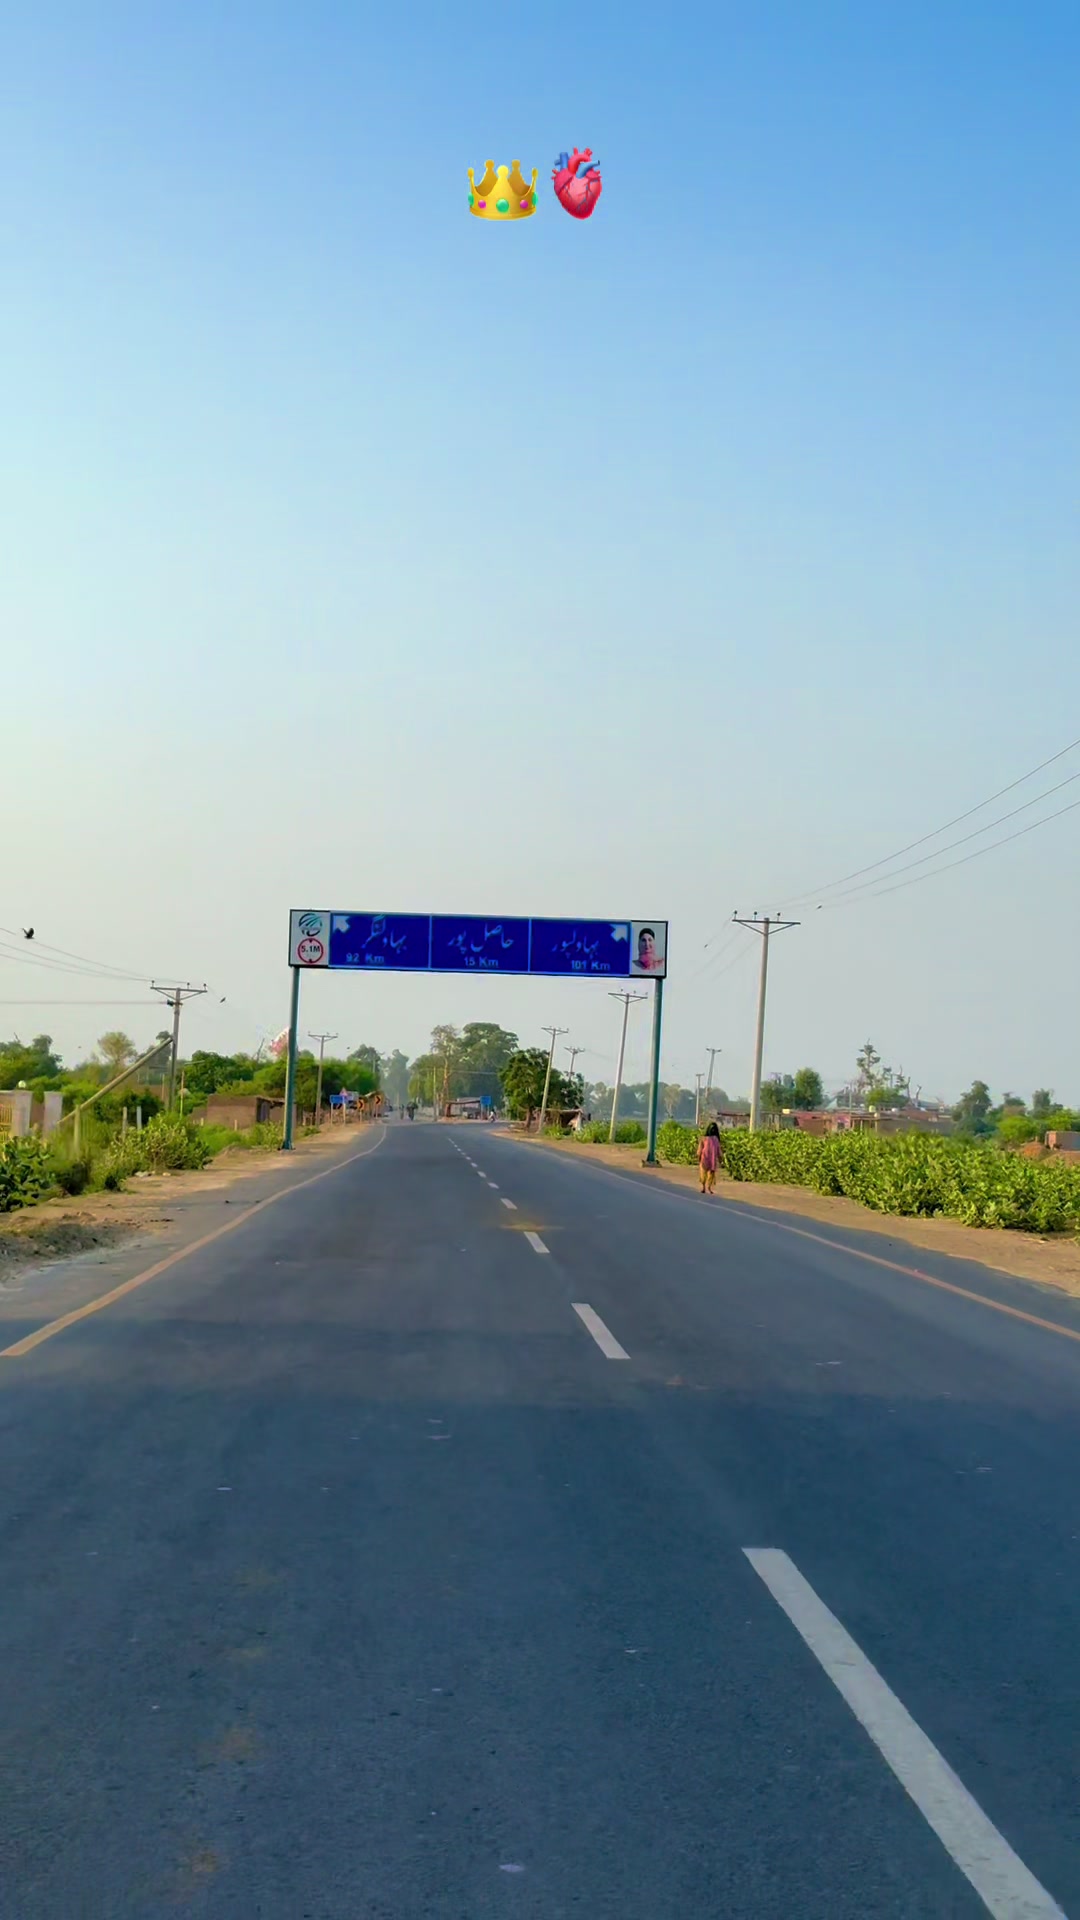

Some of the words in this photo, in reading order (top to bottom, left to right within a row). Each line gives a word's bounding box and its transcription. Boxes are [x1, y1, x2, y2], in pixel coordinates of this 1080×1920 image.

[301, 945, 320, 953] 5.1M
[346, 953, 359, 963] 92
[365, 953, 385, 964] Km
[464, 956, 476, 967] 15
[479, 957, 499, 968] Km
[571, 960, 587, 970] 101
[591, 961, 611, 971] Km
